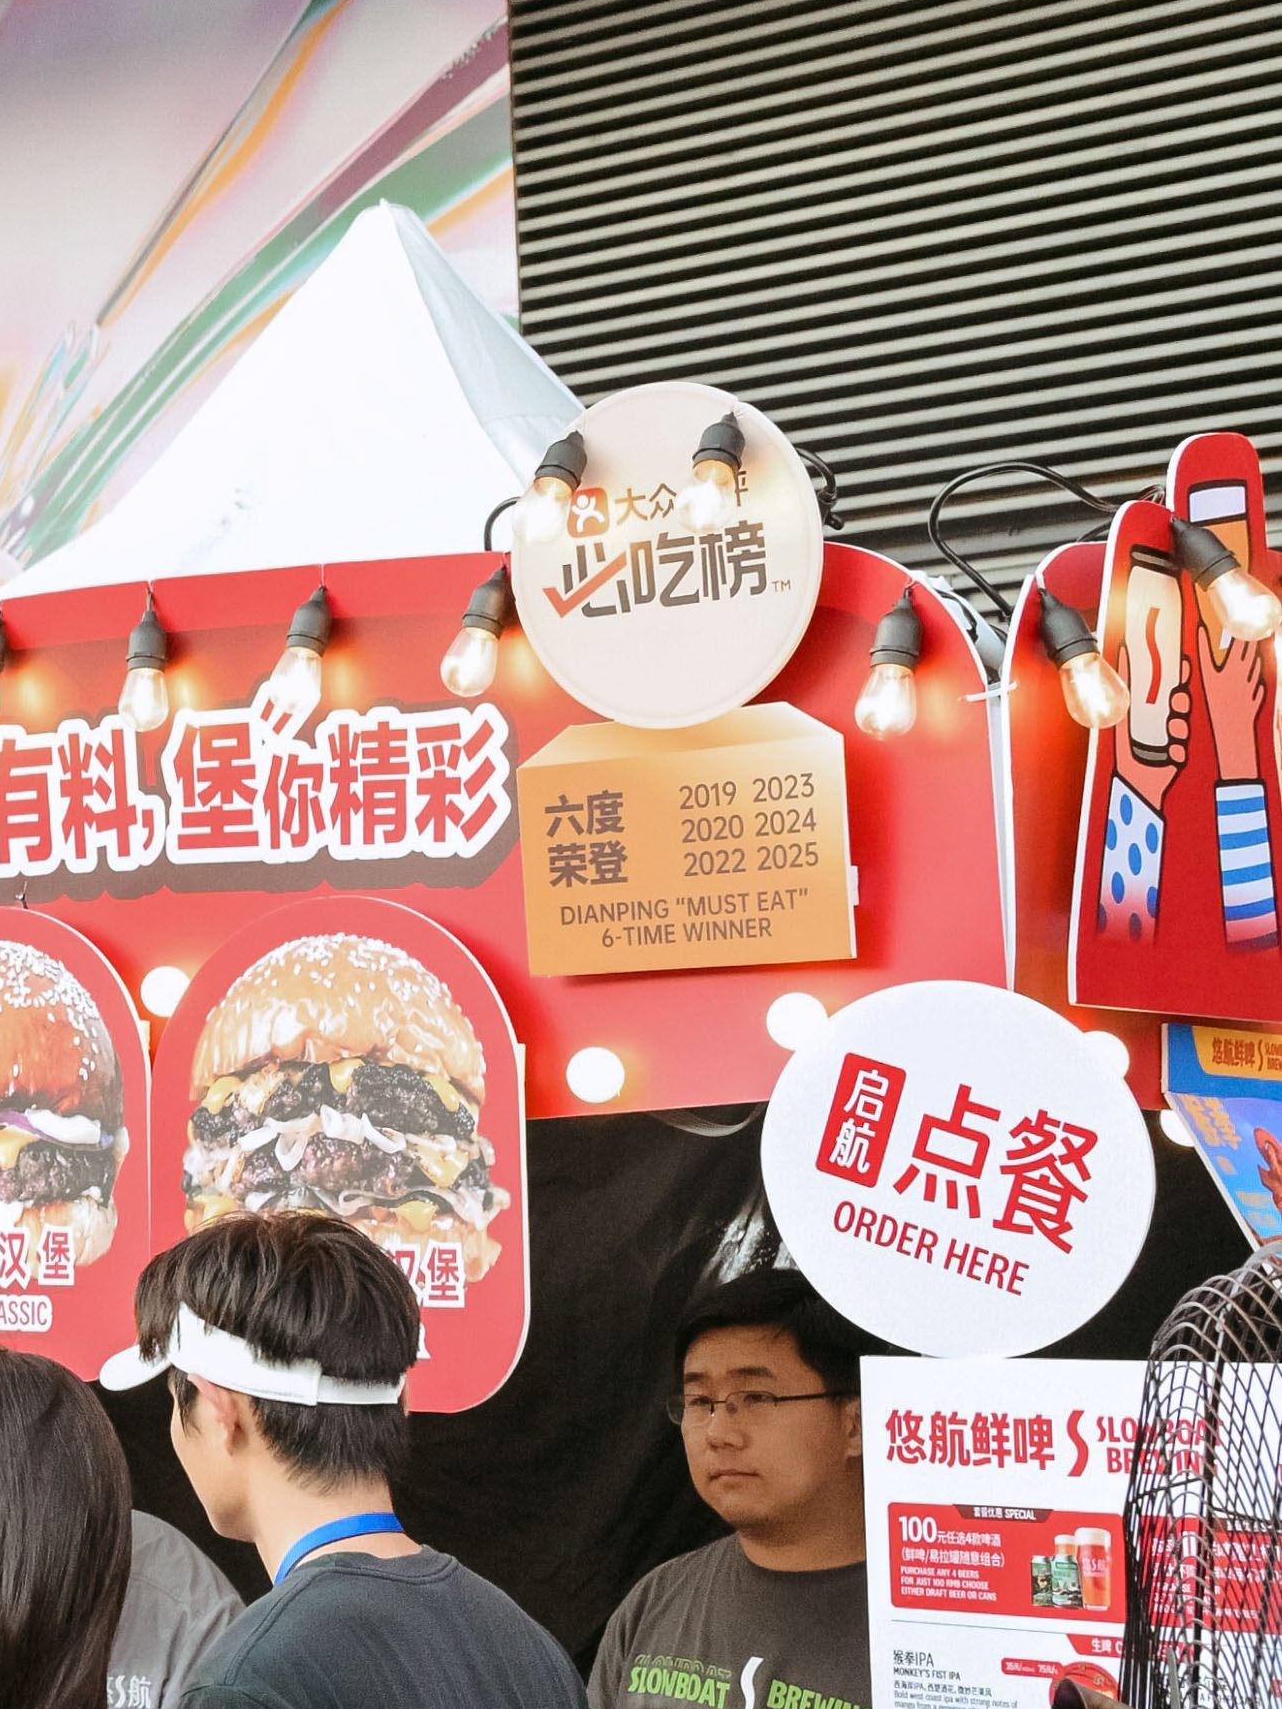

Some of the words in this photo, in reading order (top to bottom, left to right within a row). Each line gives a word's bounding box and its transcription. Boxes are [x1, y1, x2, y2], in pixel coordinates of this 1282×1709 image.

[543, 520, 768, 618] 必吃榜
[678, 780, 738, 811] 2019
[752, 773, 815, 803] 2023
[544, 790, 625, 838] 六度
[681, 815, 745, 845] 2020
[754, 807, 818, 838] 2024
[547, 840, 629, 888] 荣登
[683, 848, 746, 878] 2022
[757, 841, 819, 872] 2025
[560, 898, 671, 926] DIANPING
[600, 922, 676, 948] 6-TIME
[682, 916, 773, 944] WINNER
[830, 1068, 889, 1176] 启航
[893, 1083, 1099, 1254] 点餐
[833, 1200, 939, 1267] ORDER
[942, 1235, 1030, 1296] HERE
[885, 1408, 1056, 1472] 悠航鲜啤
[1004, 1508, 1037, 1520] SPECIAL
[901, 1577, 914, 1586] FOR
[916, 1577, 931, 1587] JUST
[933, 1578, 945, 1588] 100
[961, 1580, 990, 1590] CHOOSE
[937, 1568, 951, 1577] ANY
[958, 1569, 980, 1579] BEERS
[901, 1587, 925, 1597] EITHER
[926, 1588, 948, 1598] DRAFT
[949, 1589, 967, 1600] BEER
[967, 1590, 978, 1600] OR
[978, 1591, 998, 1602] CANS
[628, 1666, 731, 1709] SLOWBOAT
[893, 1667, 931, 1679] MONKEY'S
[932, 1670, 947, 1680] FIST
[949, 1671, 961, 1681] IPA
[955, 1695, 969, 1704] with
